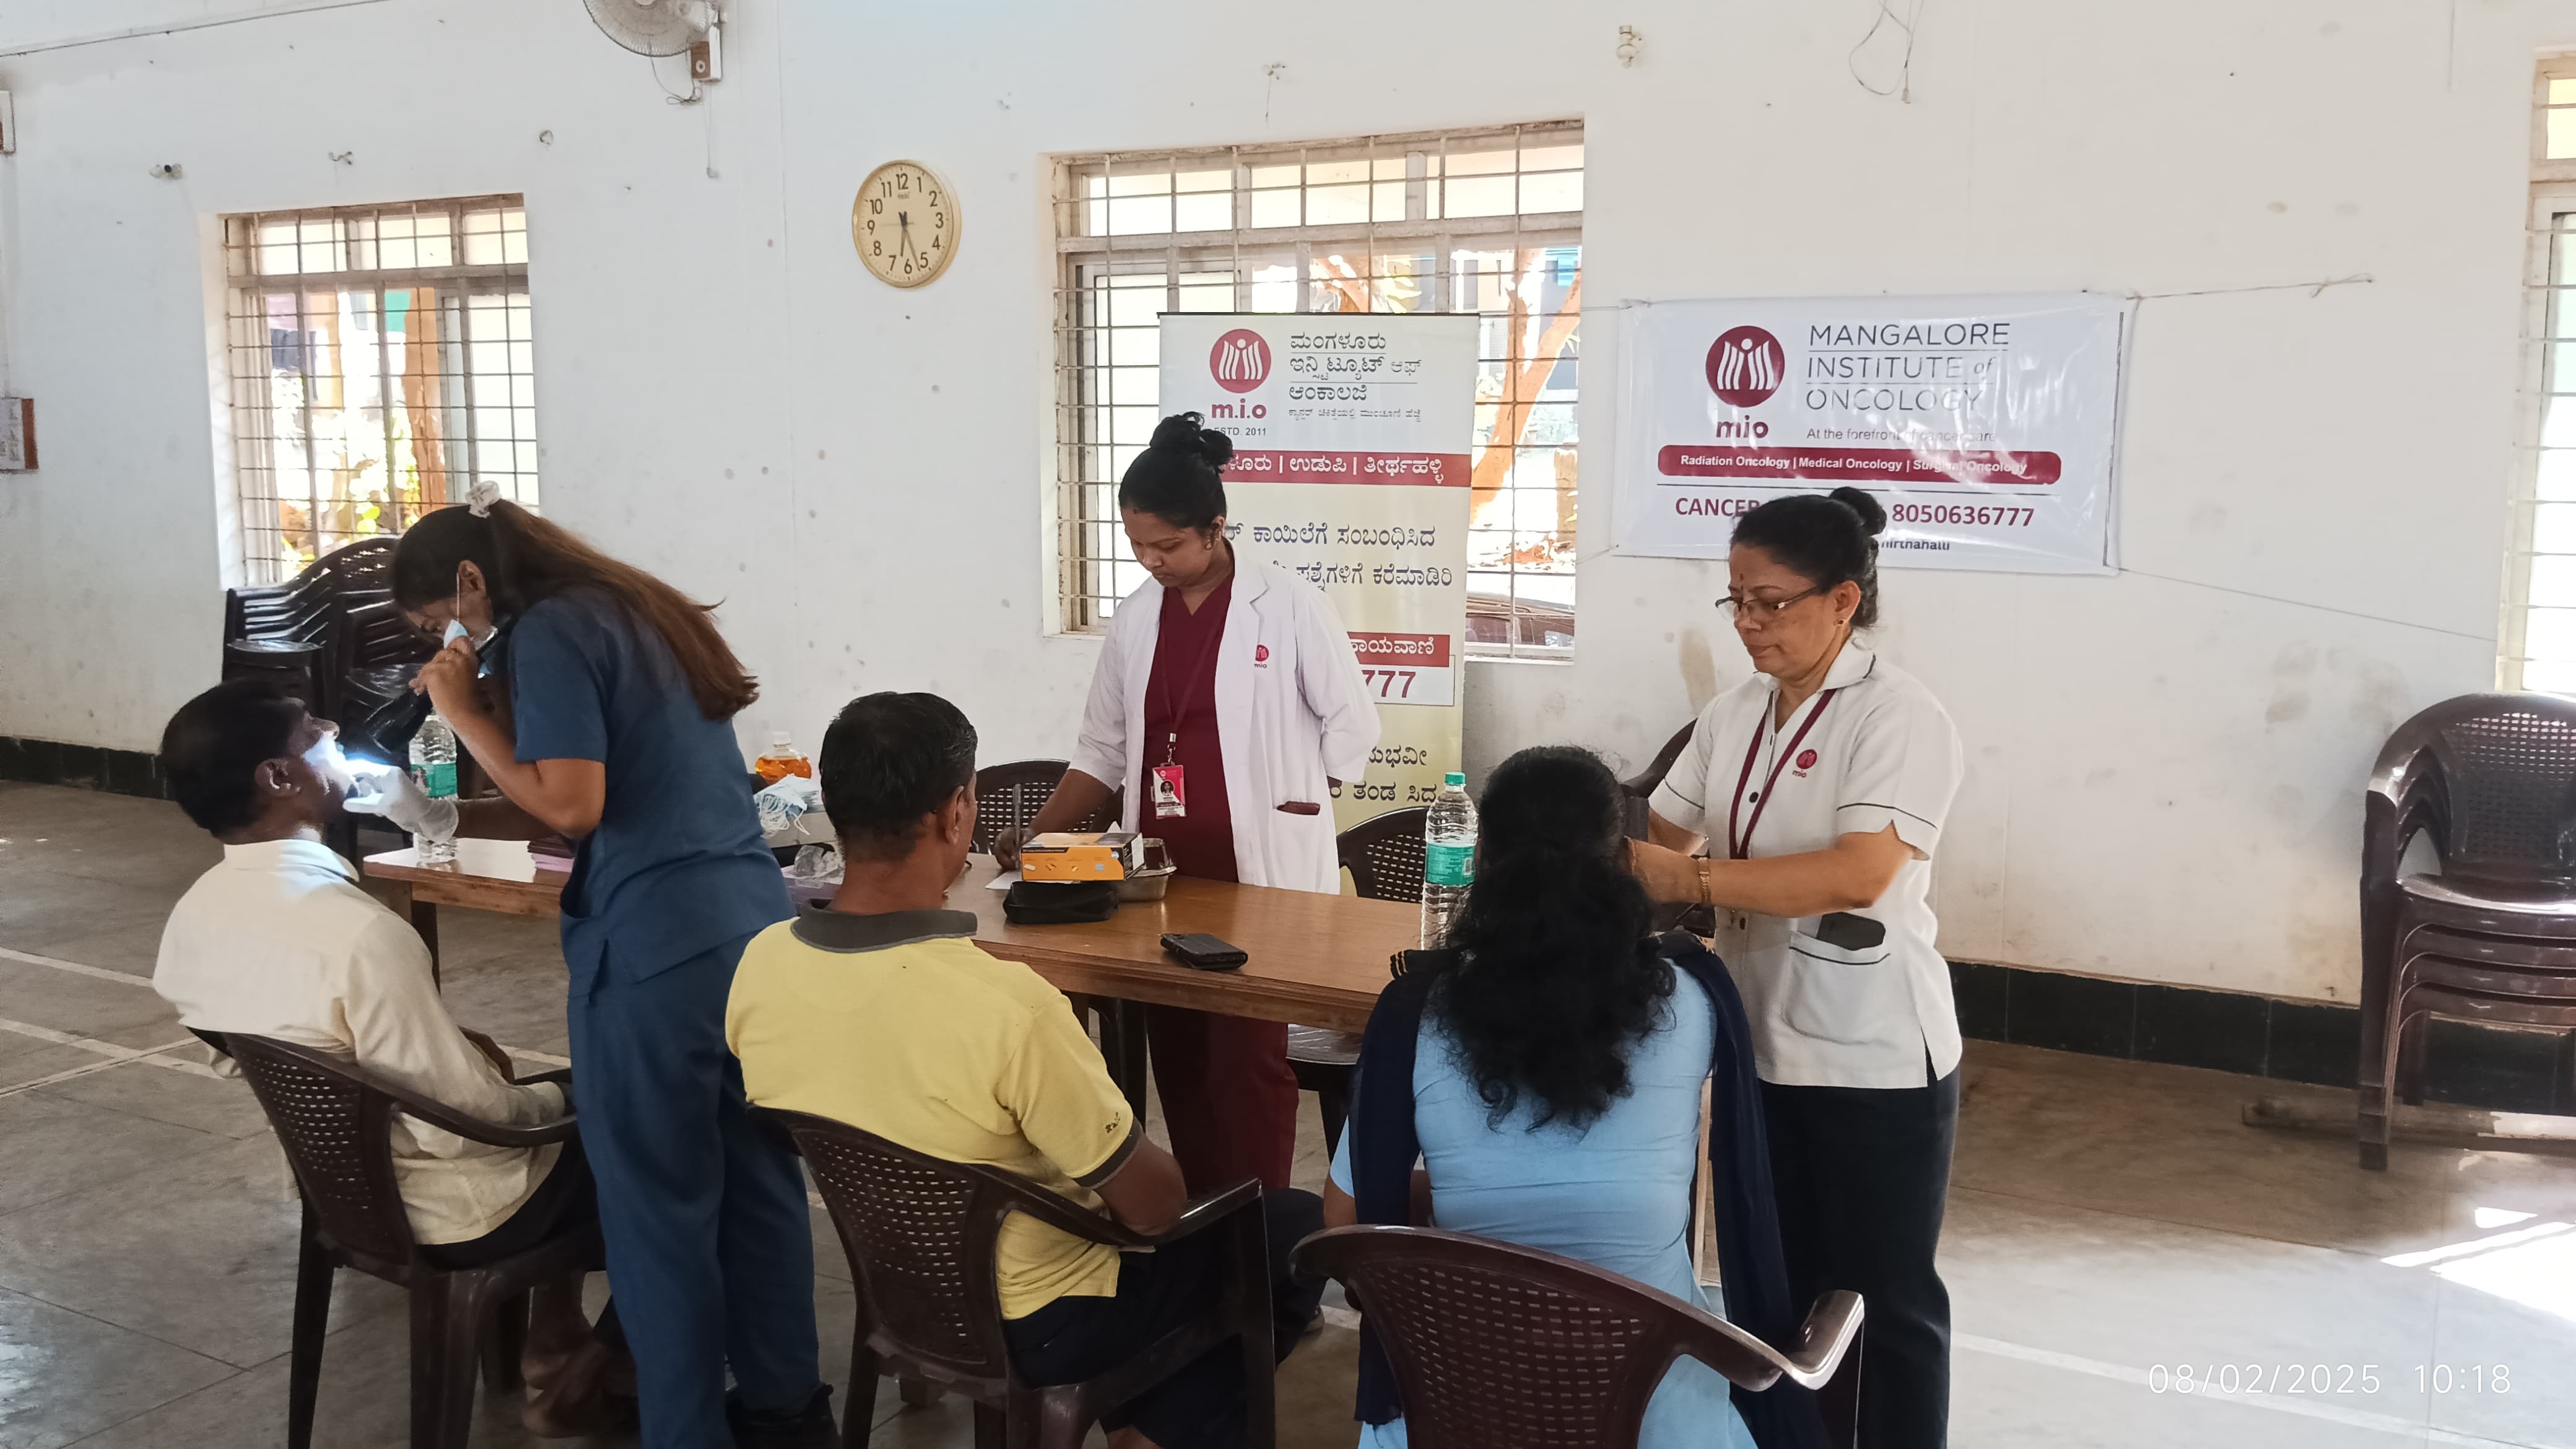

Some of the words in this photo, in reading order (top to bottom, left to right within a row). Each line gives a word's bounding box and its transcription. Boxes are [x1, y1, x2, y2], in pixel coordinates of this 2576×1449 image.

[881, 181, 892, 198] 11
[896, 173, 908, 190] 12
[916, 177, 922, 193] 1
[869, 198, 883, 215] 10
[929, 191, 938, 207] 2
[867, 220, 875, 235] 9
[935, 212, 944, 228] 3
[873, 240, 882, 256] 8
[932, 234, 941, 250] 4
[889, 255, 897, 271] 7
[904, 258, 912, 274] 6
[920, 252, 928, 268] 5
[1290, 332, 1386, 349] ಮಂಗಳೂರು
[1810, 323, 2010, 346] MANGALORE
[1808, 357, 1963, 378] INSTITUTE
[1973, 357, 1997, 375] of
[1289, 385, 1367, 400] ಆಂಕಾಲಜಿ
[1806, 389, 1983, 411] ONCOLOGY
[1246, 427, 1266, 436] 2011
[1716, 415, 1769, 438] mio
[1807, 429, 1820, 440] At
[1824, 429, 1843, 440] the
[1290, 455, 1346, 472] ಉಡುಪಿ
[1681, 455, 1733, 466] Radiation
[1736, 456, 1790, 469] Oncology
[1799, 458, 1842, 468] Medical
[1846, 458, 1902, 472] Oncology
[1913, 459, 1962, 473] Surgal
[1892, 504, 2034, 526] 8050636777
[1253, 522, 1328, 544] ಕಾಯಿಲೆಗೆ
[1337, 524, 1435, 550] ಸಂಬಂಧಿಸಿದ
[1373, 563, 1452, 586] ಕರೆಮಾಡಿರಿ
[1353, 780, 1396, 801] ತಂಡ
